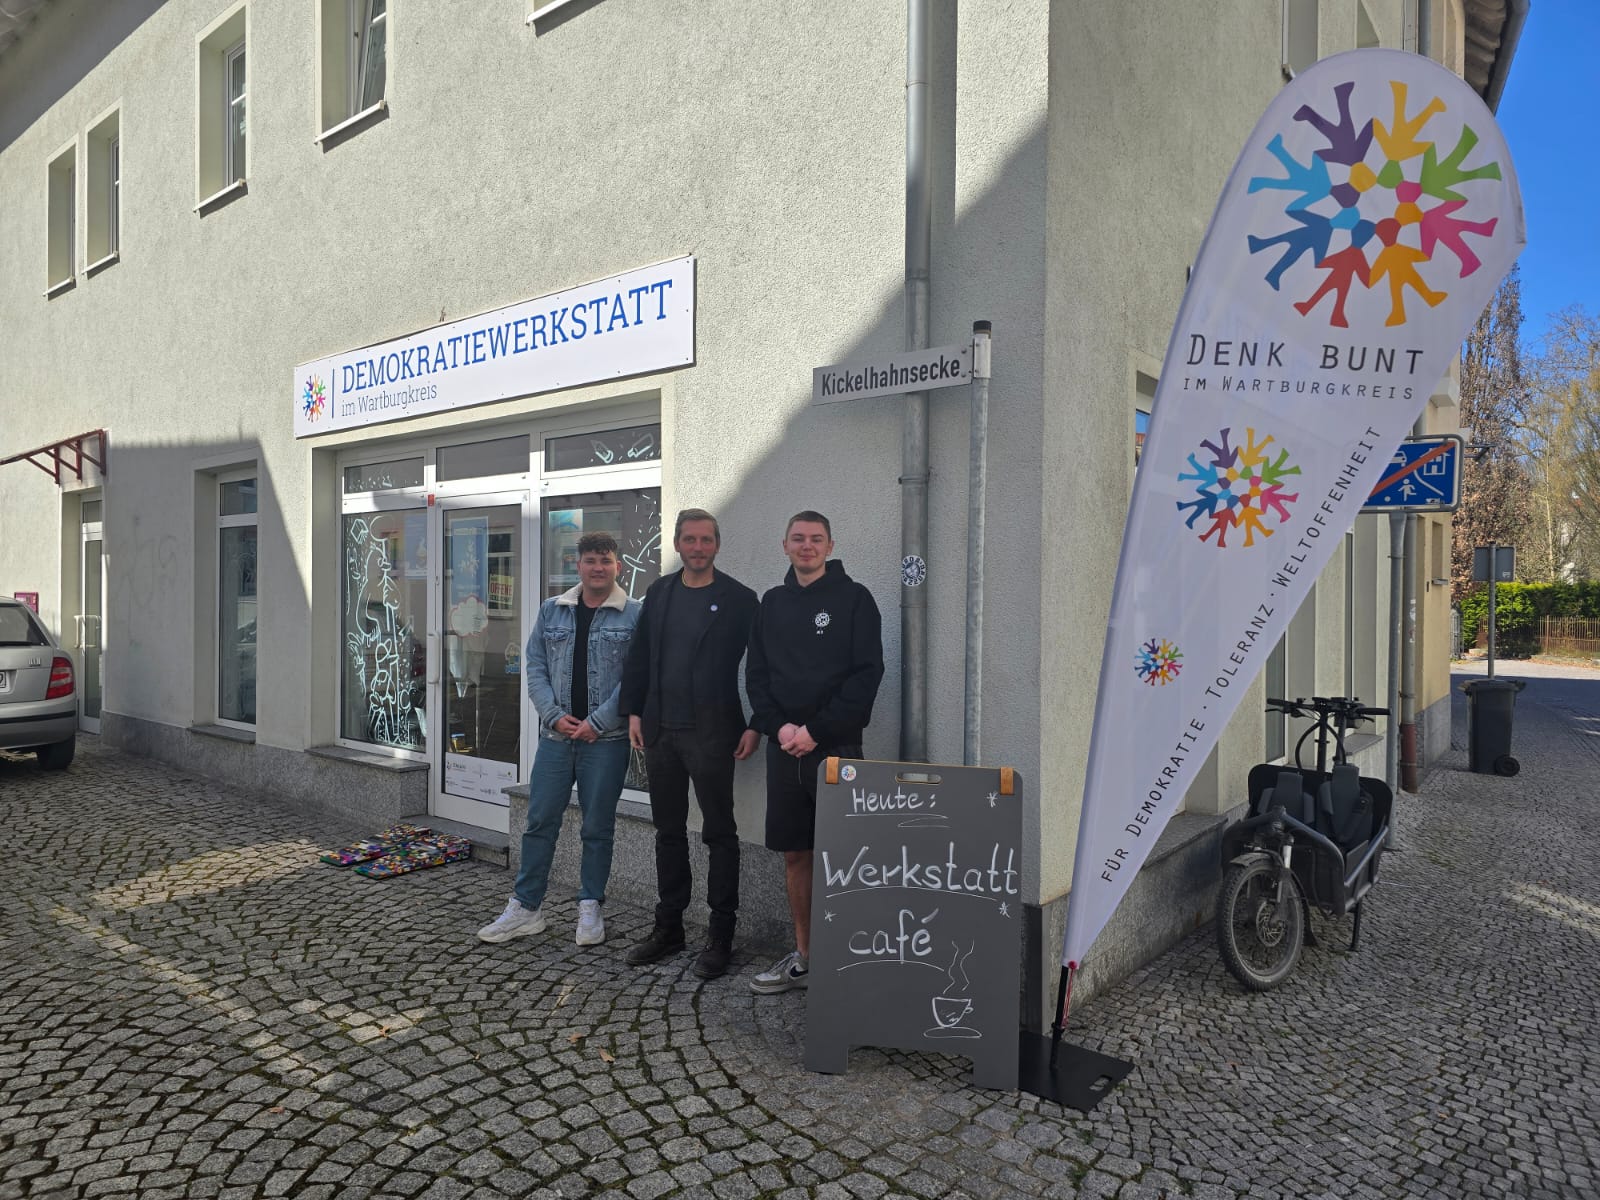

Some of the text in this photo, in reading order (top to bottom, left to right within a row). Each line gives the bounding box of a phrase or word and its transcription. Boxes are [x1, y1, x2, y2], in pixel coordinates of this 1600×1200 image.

[342, 279, 673, 394] DEMOKRATIEWERKSTATT
[1187, 334, 1423, 374] DENK BUNT
[822, 355, 960, 396] Kickelhahnsecke
[1184, 376, 1412, 399] IM WARTBURGKREIS
[341, 383, 437, 416] im Wartburgkreis
[1101, 425, 1381, 883] FÜR DEMOKRATIE TOLERANZ WELTOFFENHEIT
[852, 786, 936, 812] Heute:
[822, 841, 1018, 894] Werkstatt
[848, 908, 939, 964] café
